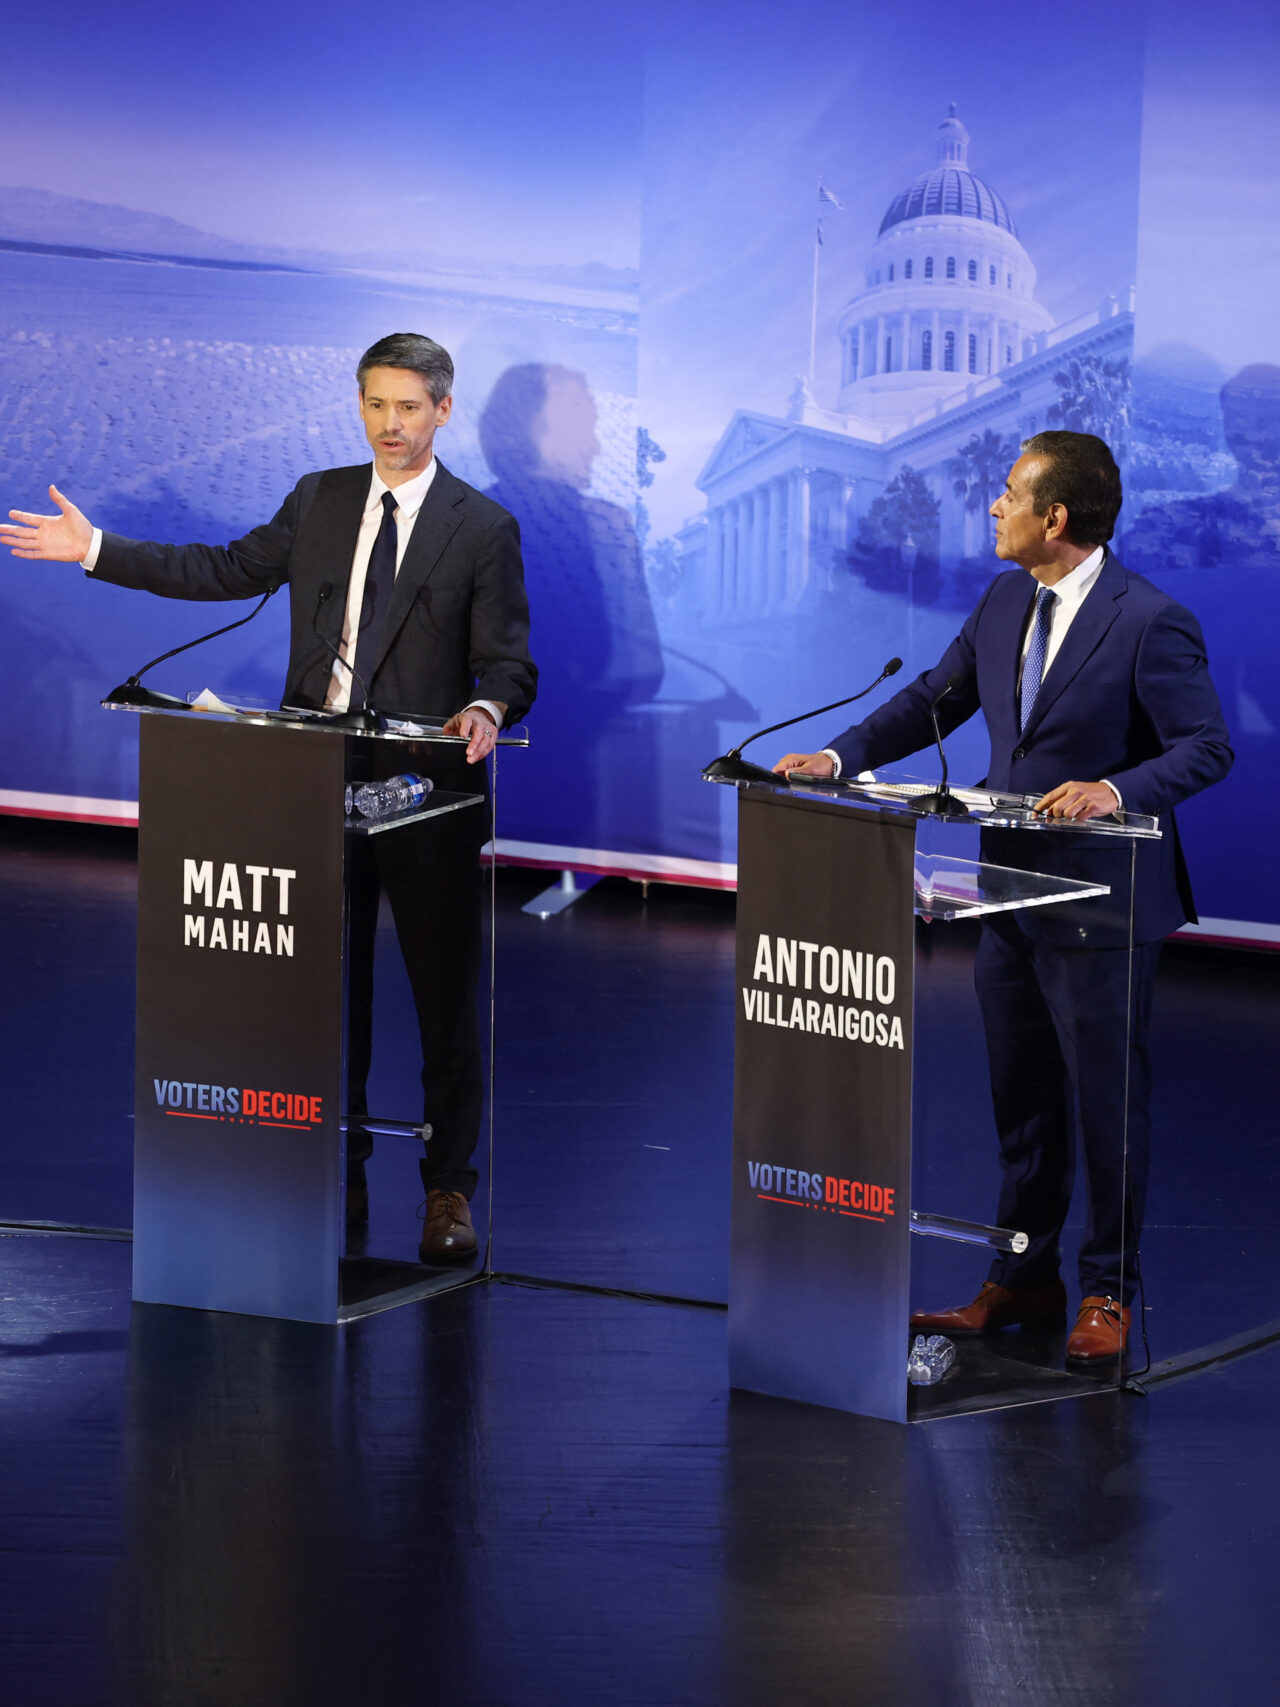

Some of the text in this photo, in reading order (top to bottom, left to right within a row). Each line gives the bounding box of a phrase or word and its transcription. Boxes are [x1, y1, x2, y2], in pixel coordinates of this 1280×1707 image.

[184, 859, 296, 915] MATT
[185, 915, 293, 956] MAHAN
[753, 934, 895, 1004] ANTONIO
[743, 988, 904, 1049] VILLARAIGOSA
